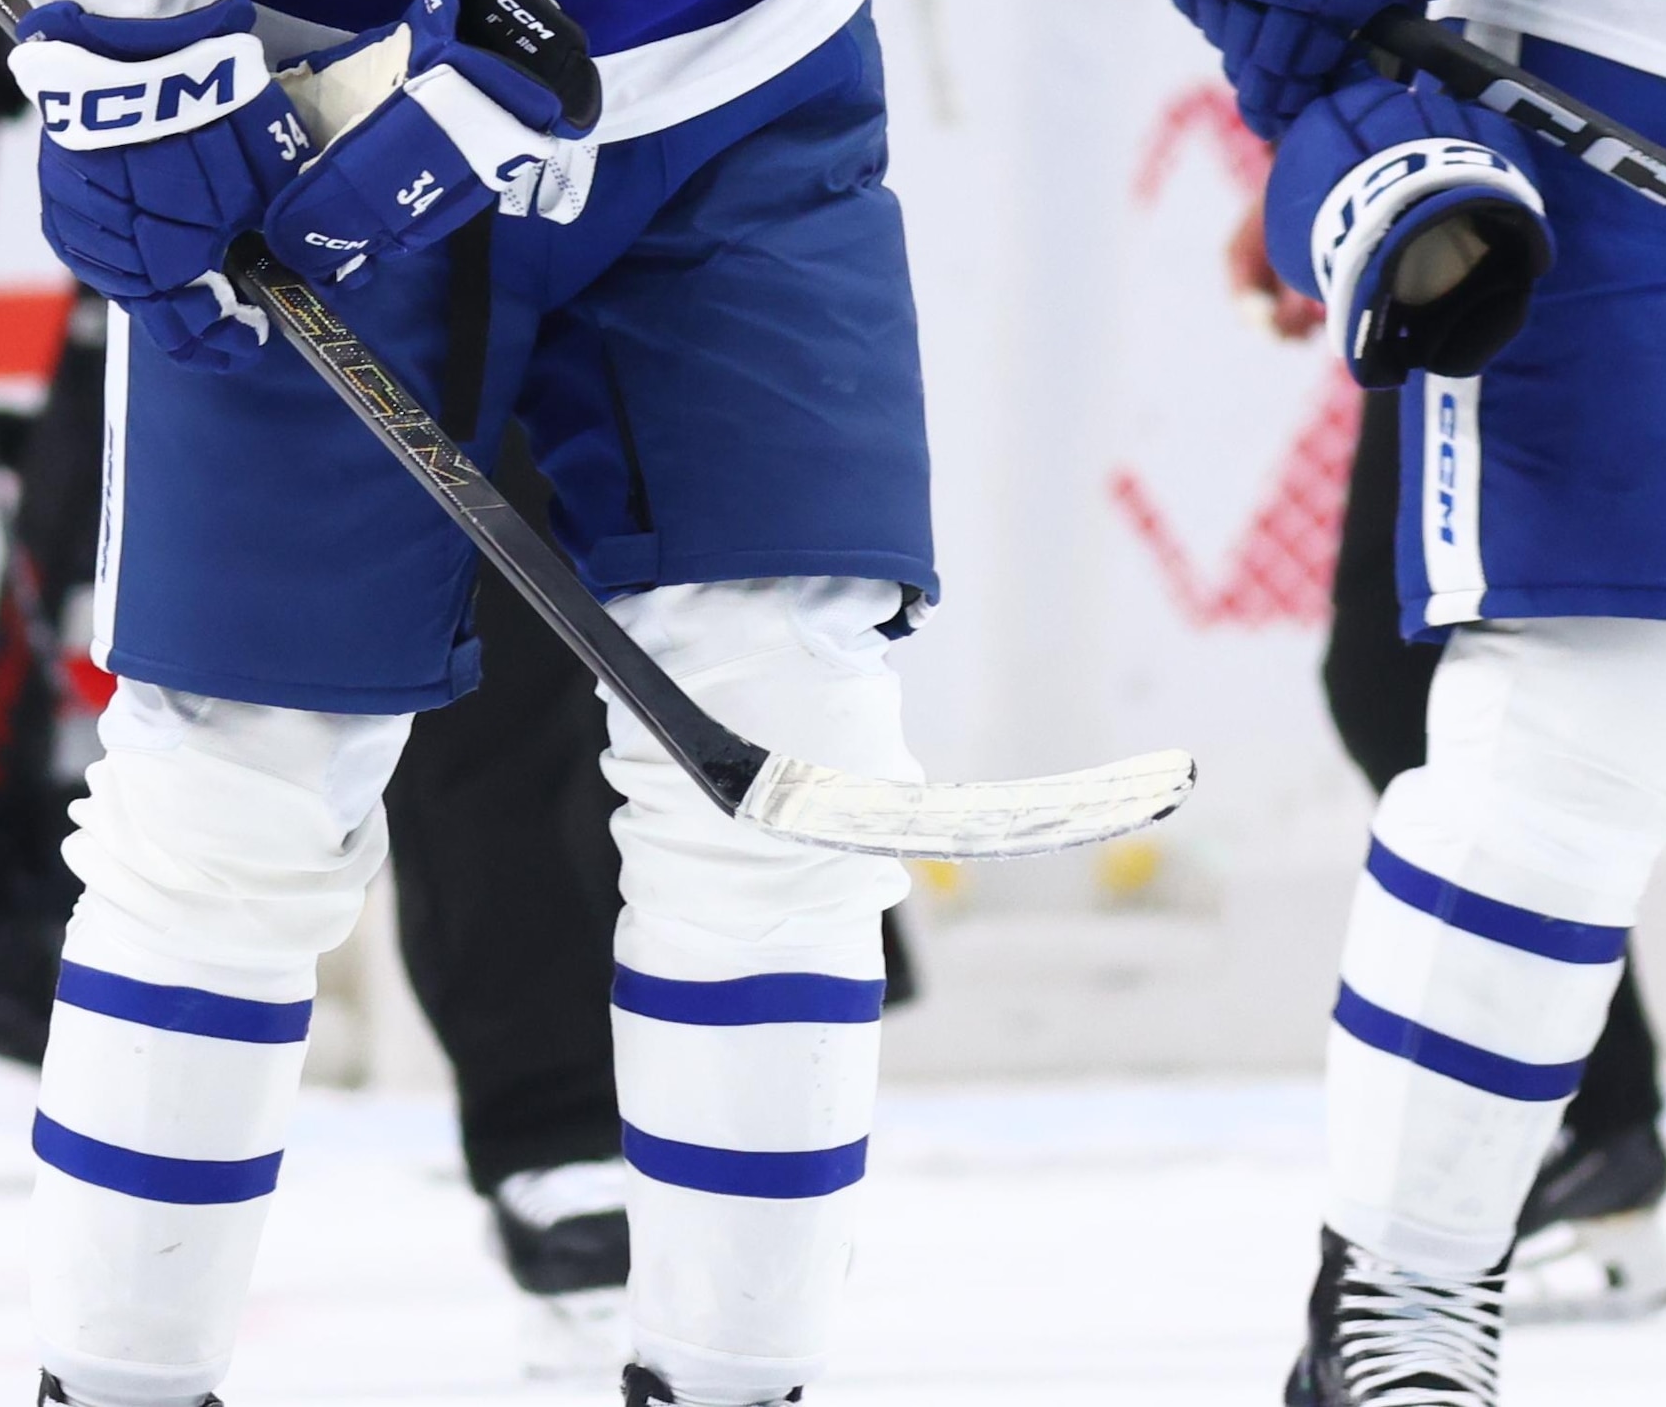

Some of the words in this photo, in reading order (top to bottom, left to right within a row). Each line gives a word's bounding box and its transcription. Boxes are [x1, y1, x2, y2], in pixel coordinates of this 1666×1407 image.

[38, 57, 237, 132] CCM
[267, 113, 310, 161] 34
[397, 171, 444, 217] 34
[305, 231, 370, 252] CCM
[1439, 393, 1456, 546] CCM
